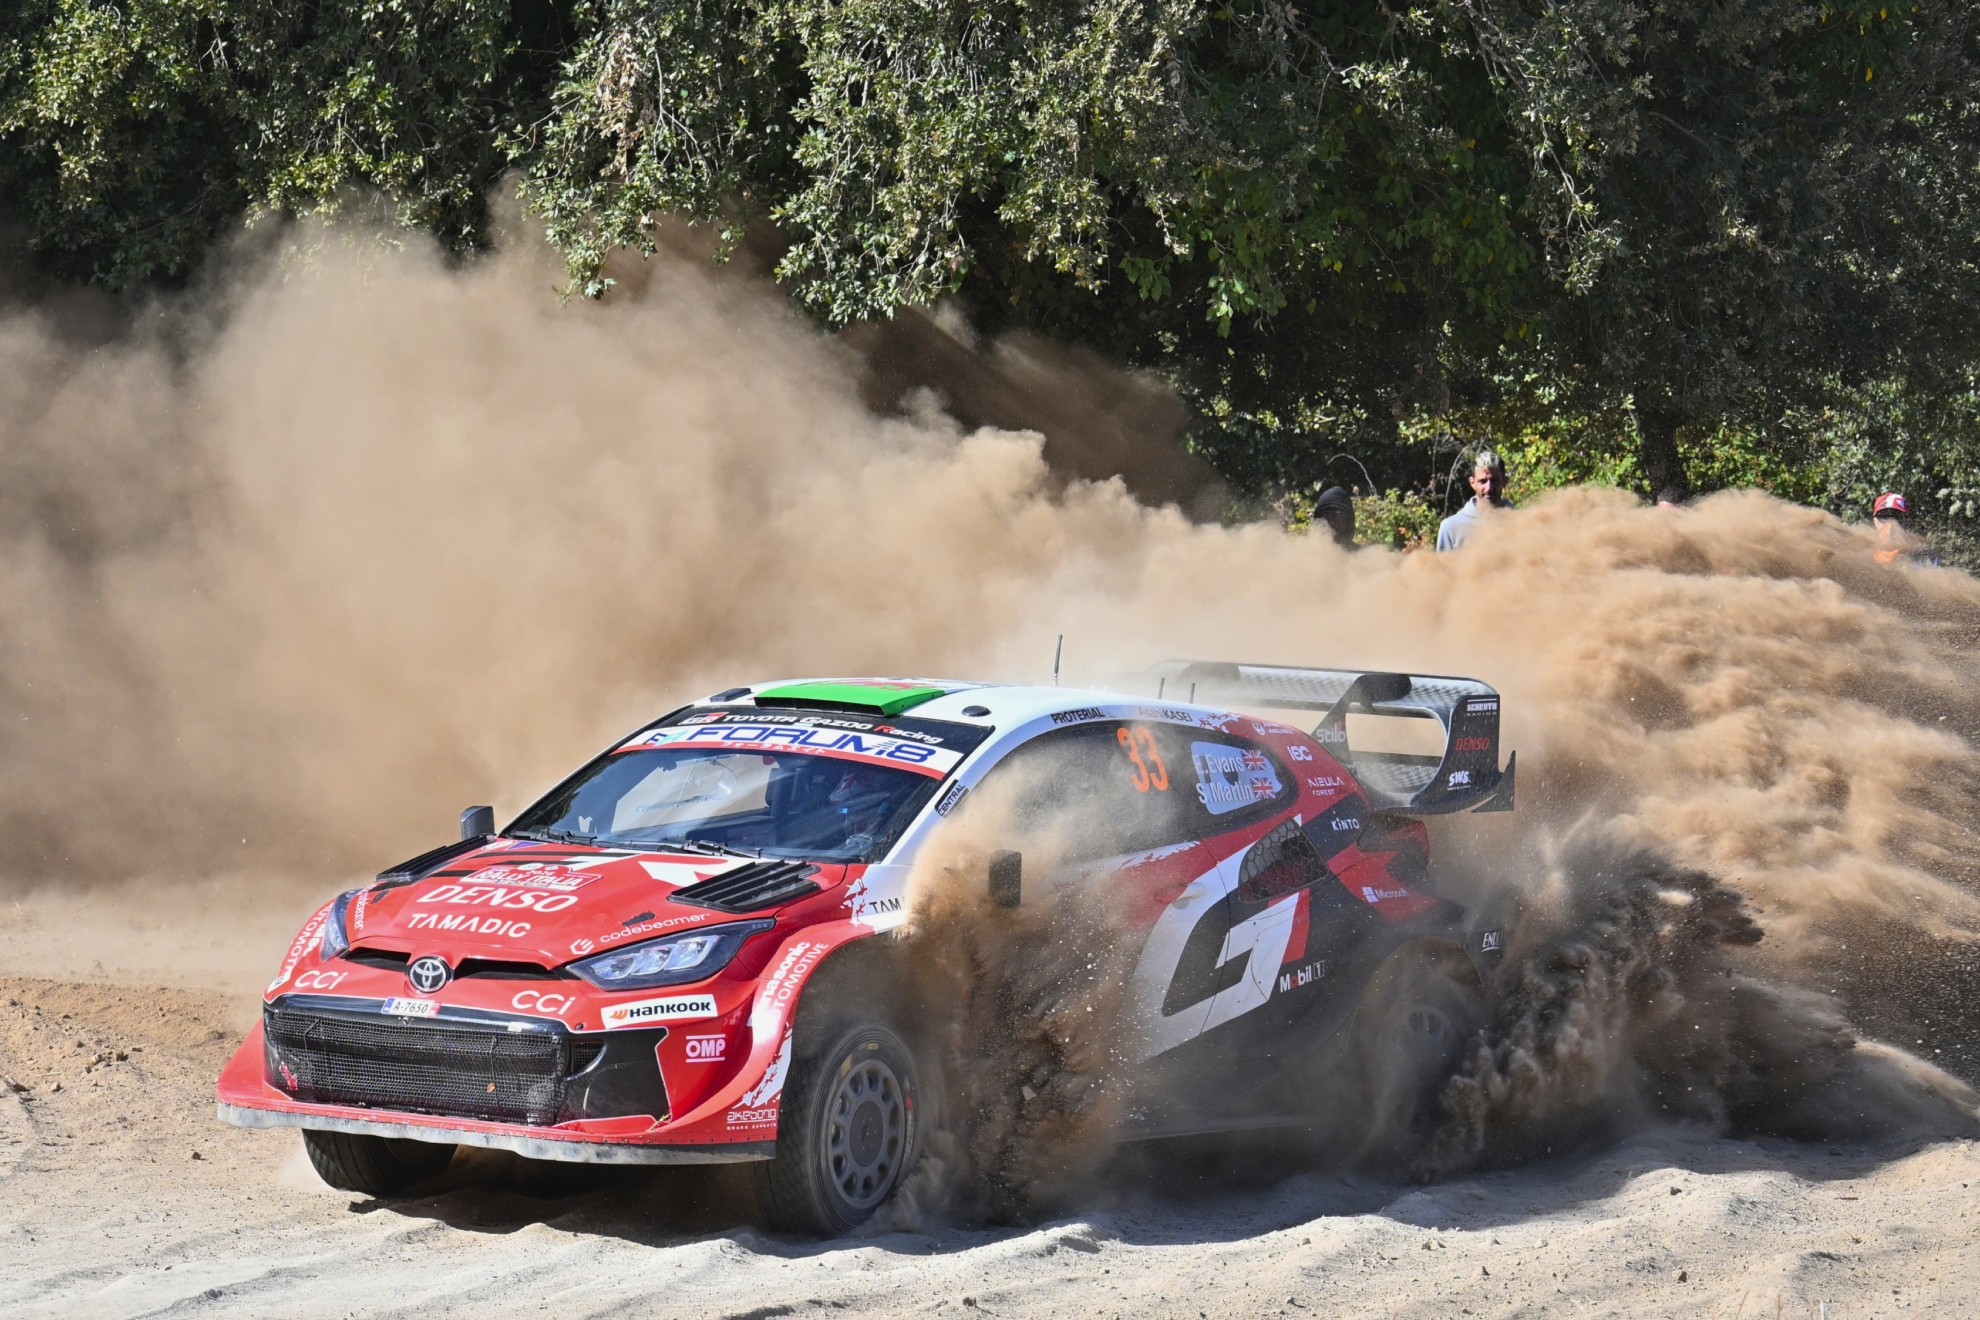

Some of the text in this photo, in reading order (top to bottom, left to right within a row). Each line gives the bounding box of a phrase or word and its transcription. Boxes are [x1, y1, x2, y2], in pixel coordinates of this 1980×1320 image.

[1050, 707, 1105, 724] PROTERIAL
[723, 715, 798, 723] TOYOTA
[800, 716, 873, 730] GAZOO
[874, 725, 944, 744] Racing
[1316, 723, 1346, 743] Stilo
[686, 726, 937, 763] FORUM8
[1455, 737, 1490, 751] DENSO
[1117, 726, 1169, 792] 33
[1192, 753, 1245, 774] E.Evans
[1449, 771, 1470, 786] SWS
[938, 784, 966, 816] CENTRAL
[1196, 780, 1254, 803] S.Martin
[475, 869, 530, 880] RALLY
[528, 875, 583, 887] ITALIA
[416, 885, 578, 912] DENSO
[407, 913, 531, 938] TAMADIC
[600, 913, 706, 943] codebeamer
[1280, 965, 1312, 993] Mobil
[393, 1001, 428, 1014] A-7650
[686, 1039, 726, 1057] OMP
[727, 1108, 777, 1121] akebono
